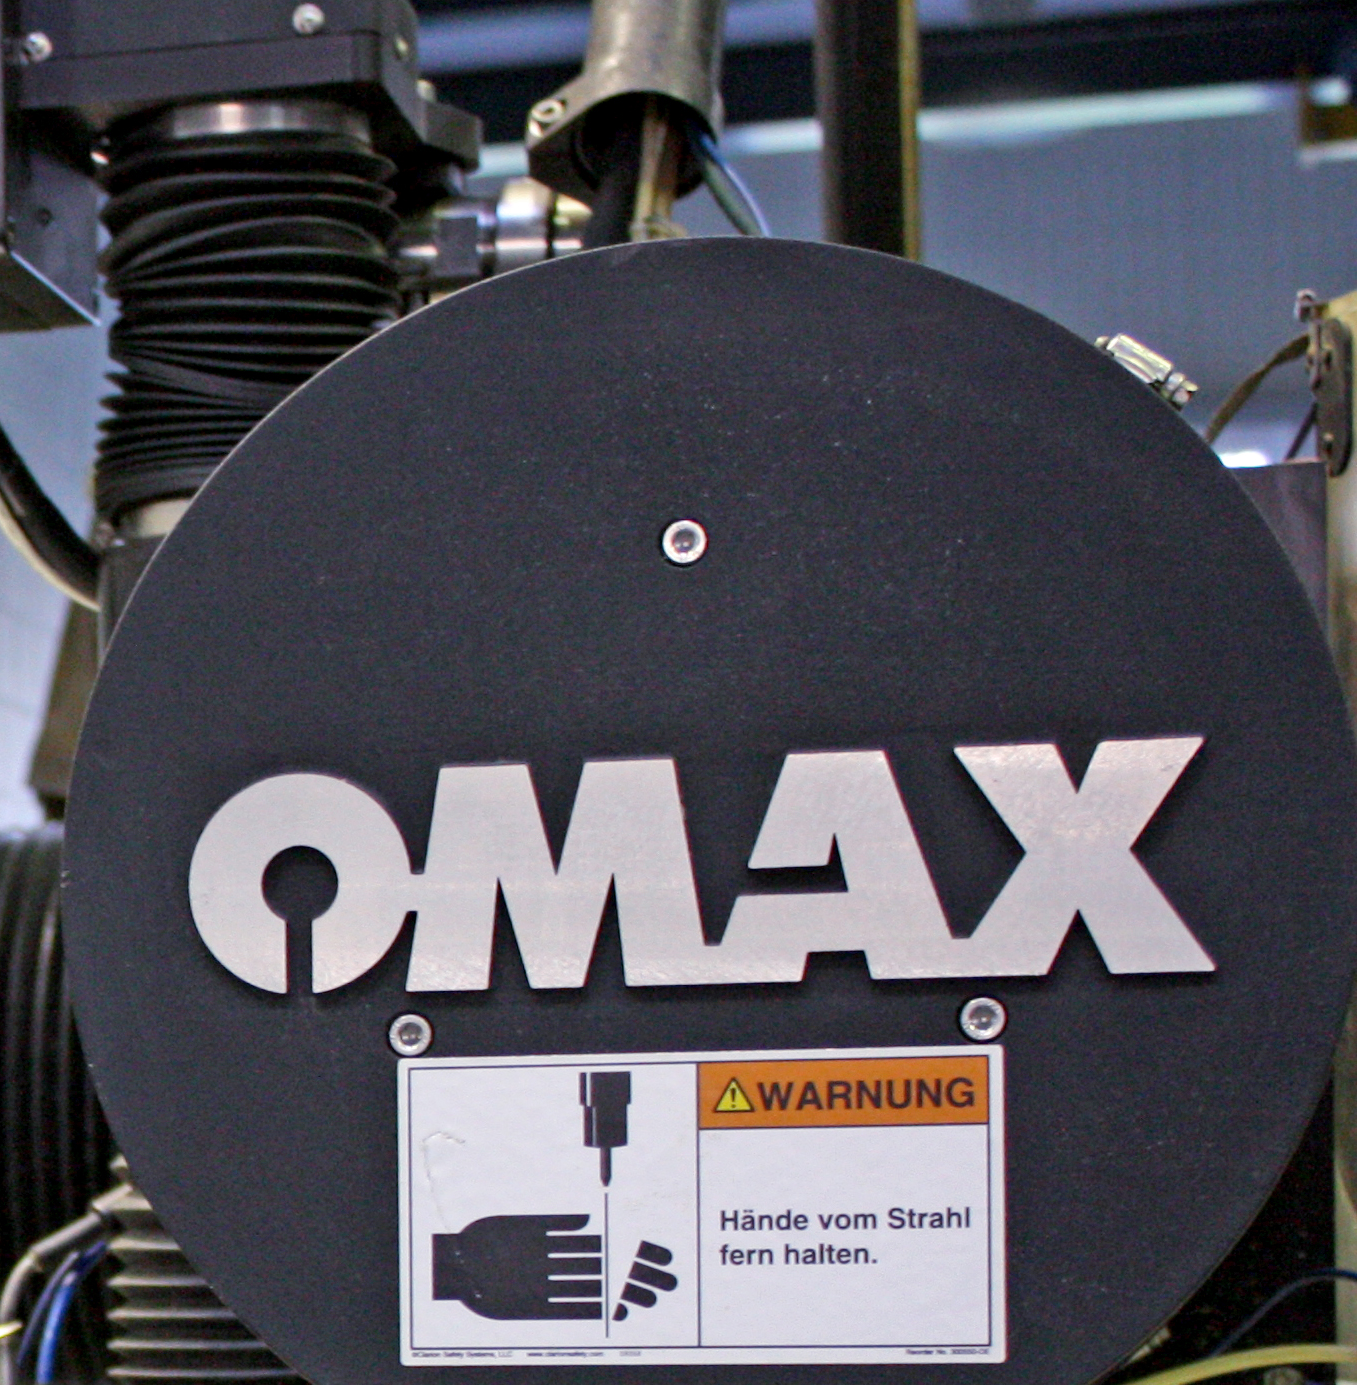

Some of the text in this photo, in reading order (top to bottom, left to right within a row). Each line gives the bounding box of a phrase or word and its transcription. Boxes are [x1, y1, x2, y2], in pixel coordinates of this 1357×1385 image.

[187, 735, 1218, 994] OMAX
[756, 1076, 976, 1112] WARNUNG
[719, 1206, 971, 1232] Hände vom Strahl
[719, 1242, 879, 1266] fern halten.
